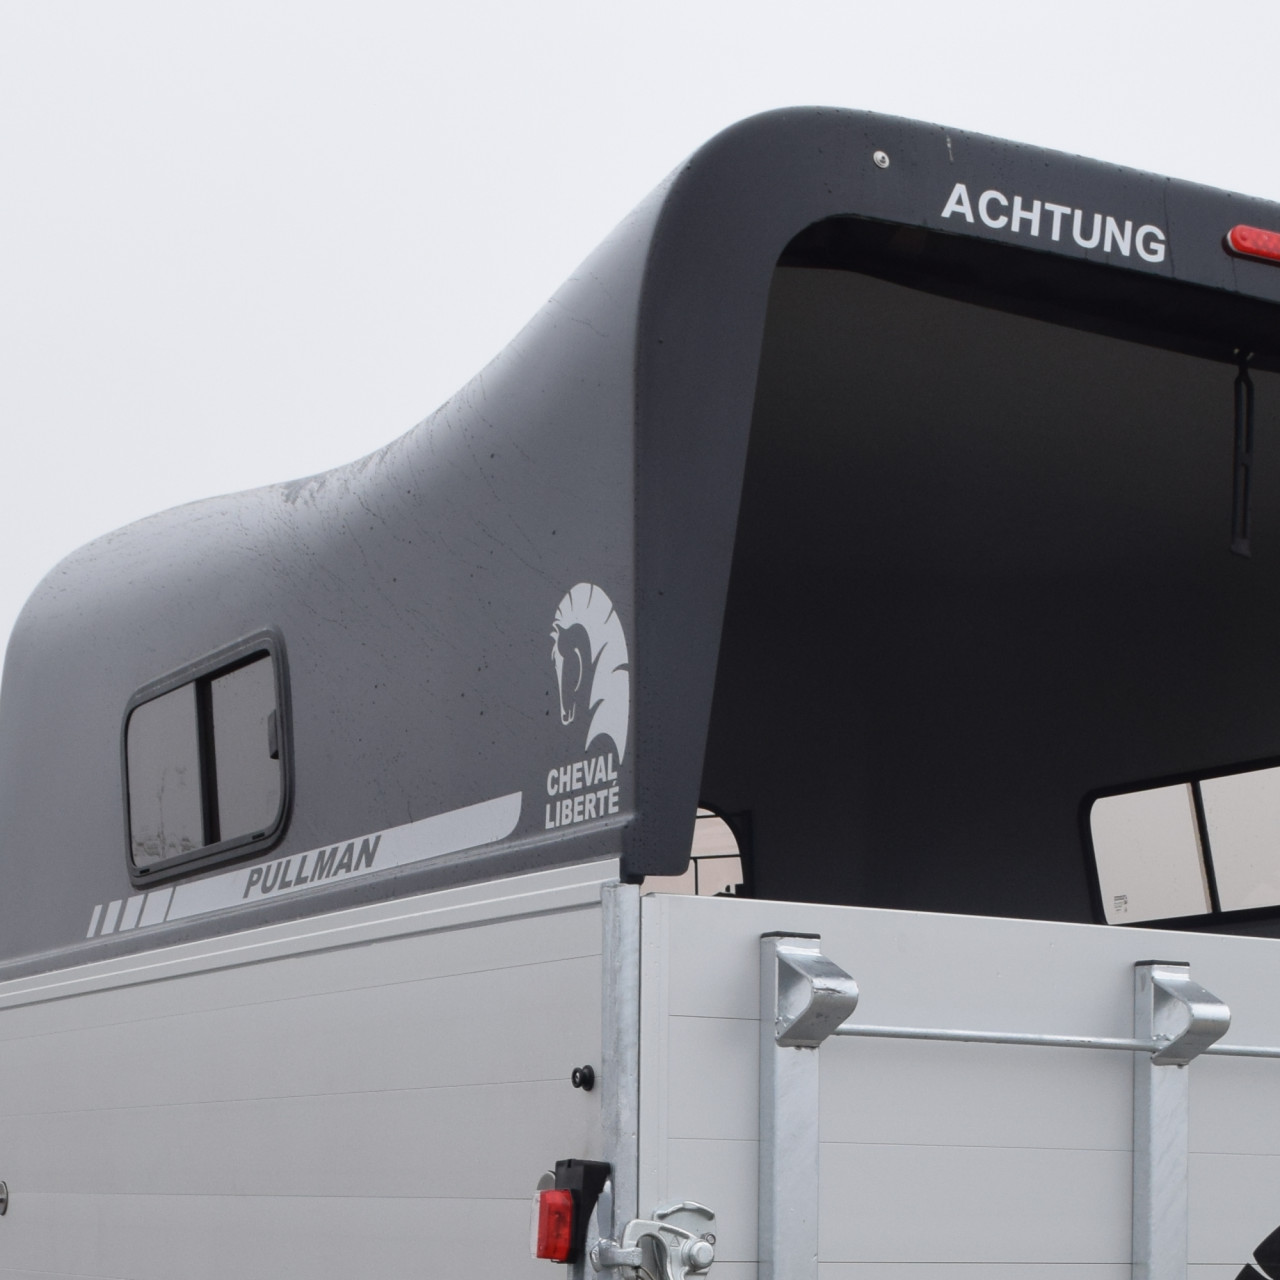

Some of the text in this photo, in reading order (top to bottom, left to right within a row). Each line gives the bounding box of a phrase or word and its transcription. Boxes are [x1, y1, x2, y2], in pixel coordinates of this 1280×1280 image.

[941, 183, 1167, 263] ACHTUNG
[547, 753, 618, 796] CHEVAL
[545, 780, 620, 830] LIBERTÉ
[242, 835, 381, 899] PULLMAN
